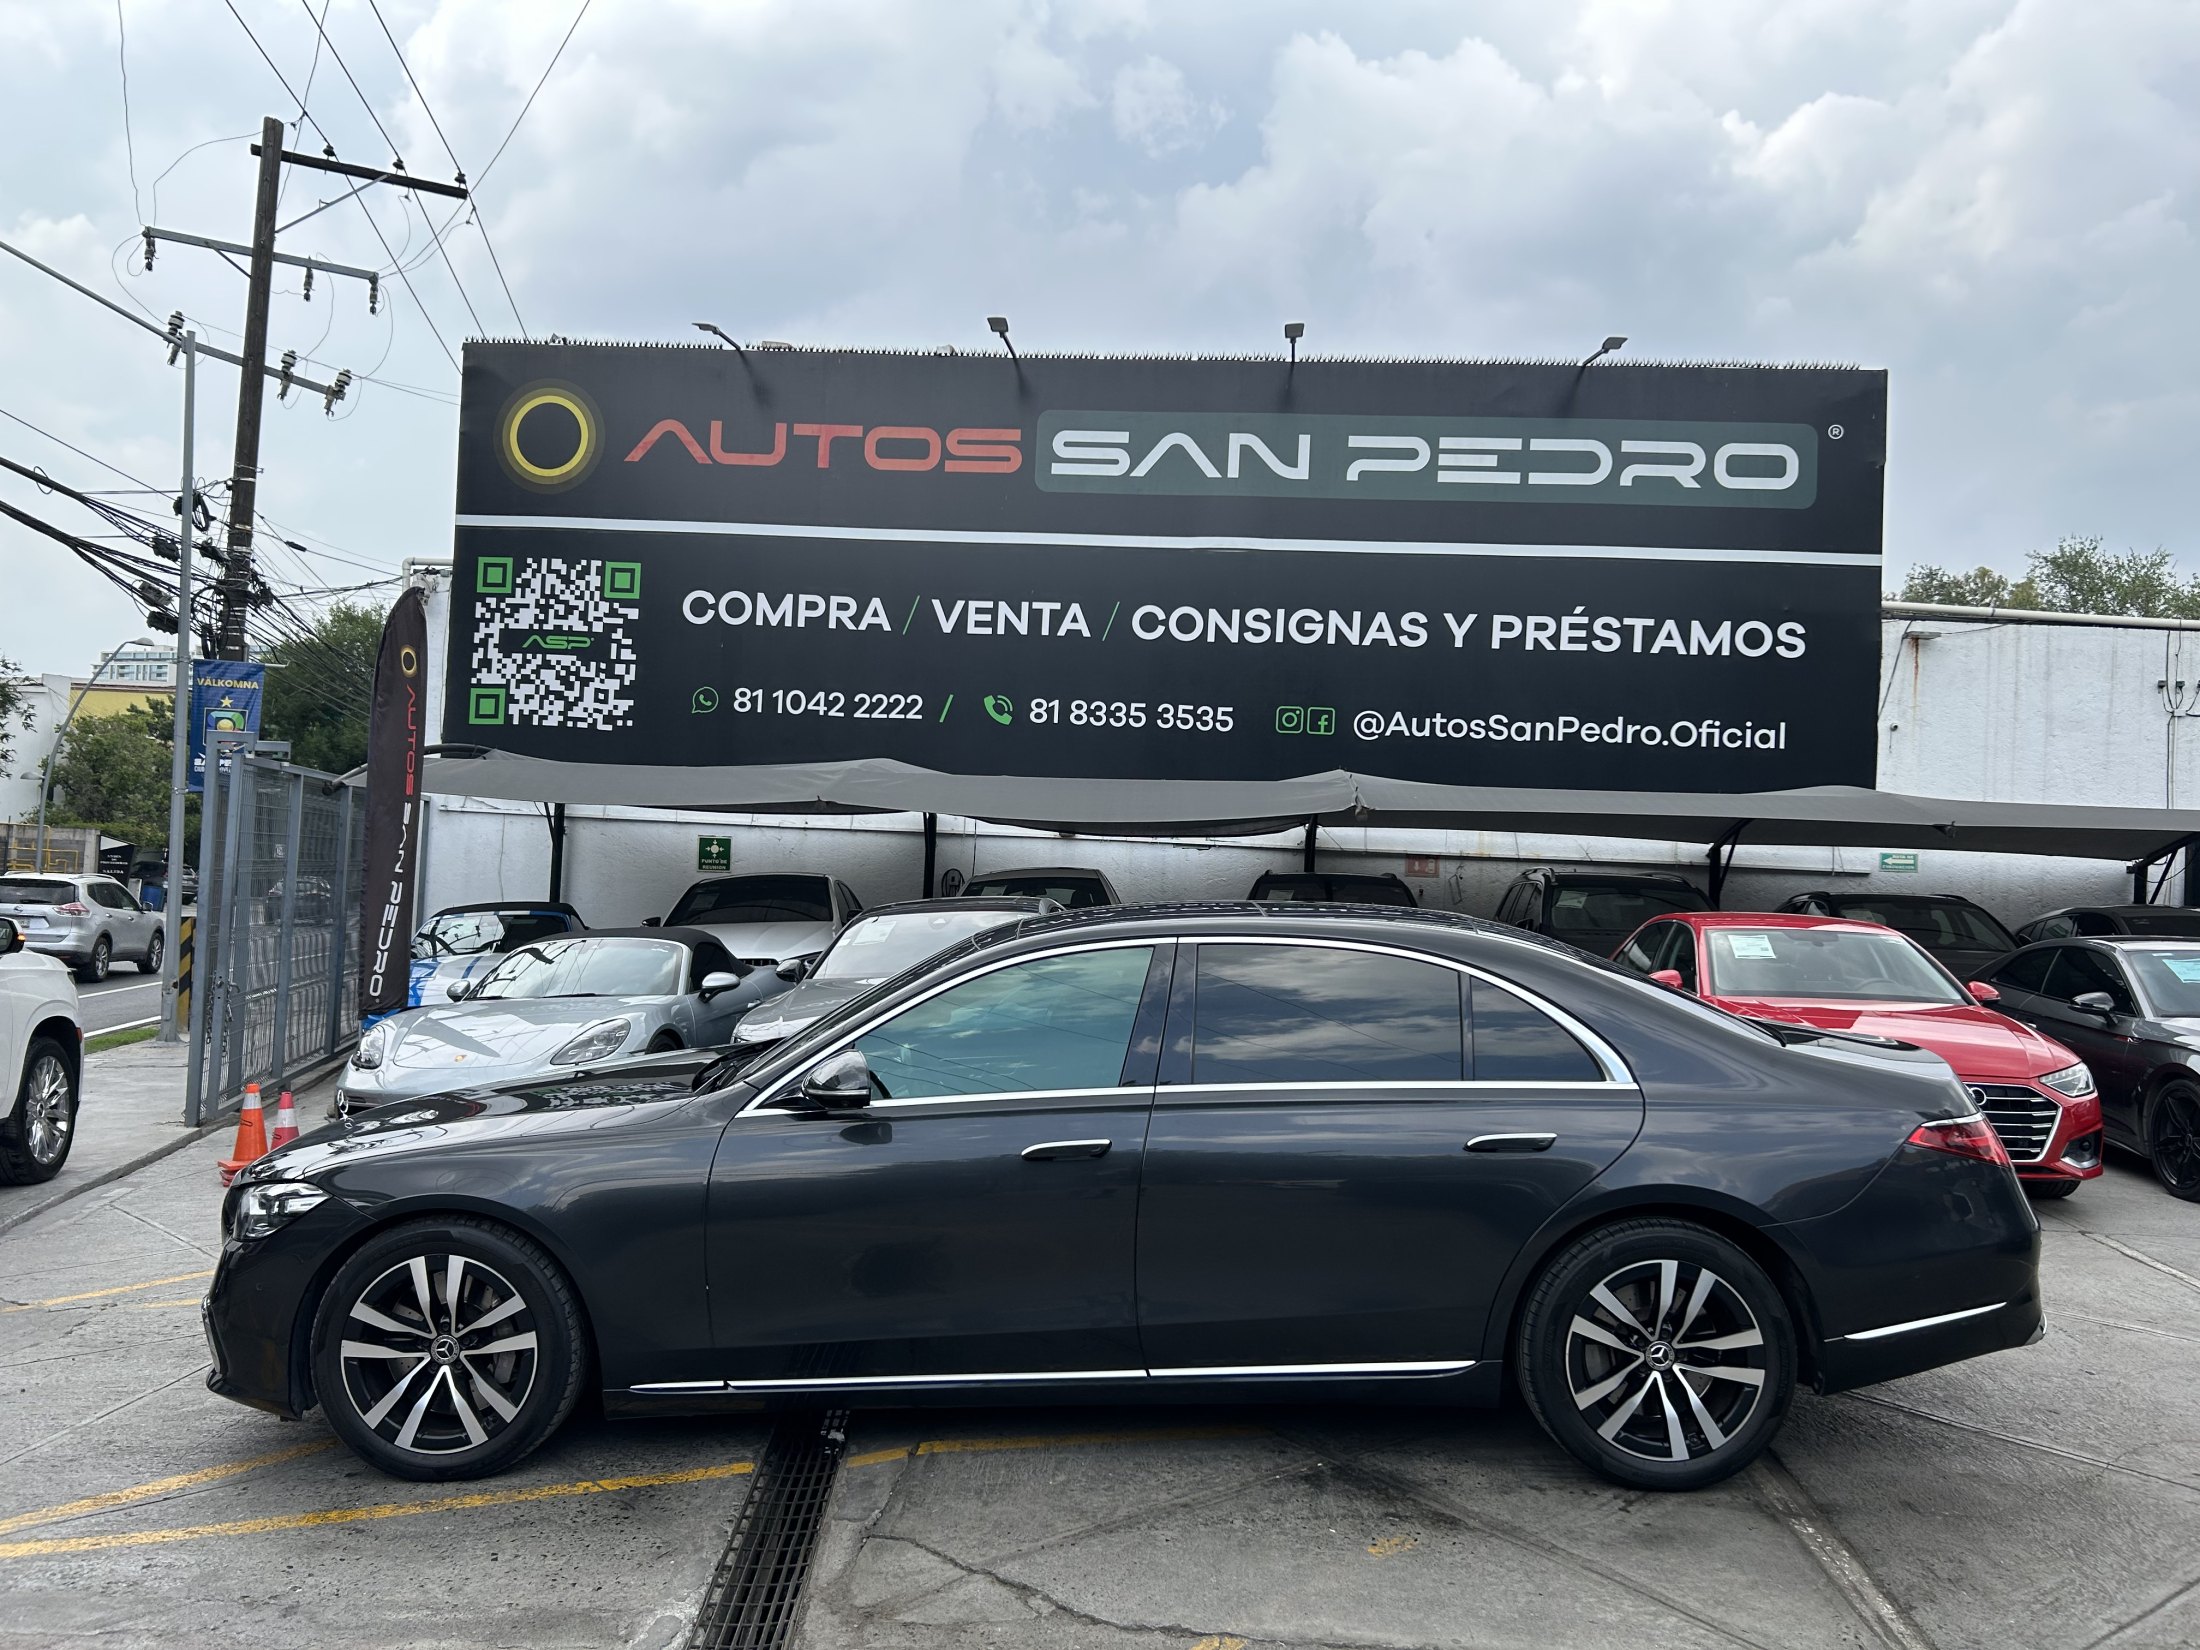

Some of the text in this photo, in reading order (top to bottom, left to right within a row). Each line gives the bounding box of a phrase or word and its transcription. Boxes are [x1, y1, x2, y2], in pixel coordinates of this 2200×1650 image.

[623, 418, 1023, 473] AUTOS
[1050, 430, 1311, 480] SAN
[1346, 435, 1800, 490] PEDRO
[522, 633, 592, 650] ASP
[682, 589, 893, 632] COMPRA
[931, 598, 1091, 638] VENTA
[1131, 604, 1429, 648] CONSIGNAS
[1443, 612, 1478, 649] Y
[1491, 605, 1807, 659] PRÉSTAMOS
[196, 676, 259, 690] VÄLKOMNA
[733, 687, 763, 713] 81
[773, 689, 845, 717] 1042
[853, 693, 923, 720] 2222
[1029, 698, 1060, 724] 81
[1069, 699, 1147, 728] 8335
[1156, 703, 1234, 732] 3535
[1353, 710, 1787, 749] @AutosSanPedro.Oficial
[369, 684, 417, 997] AUTOS SAN PEDRO
